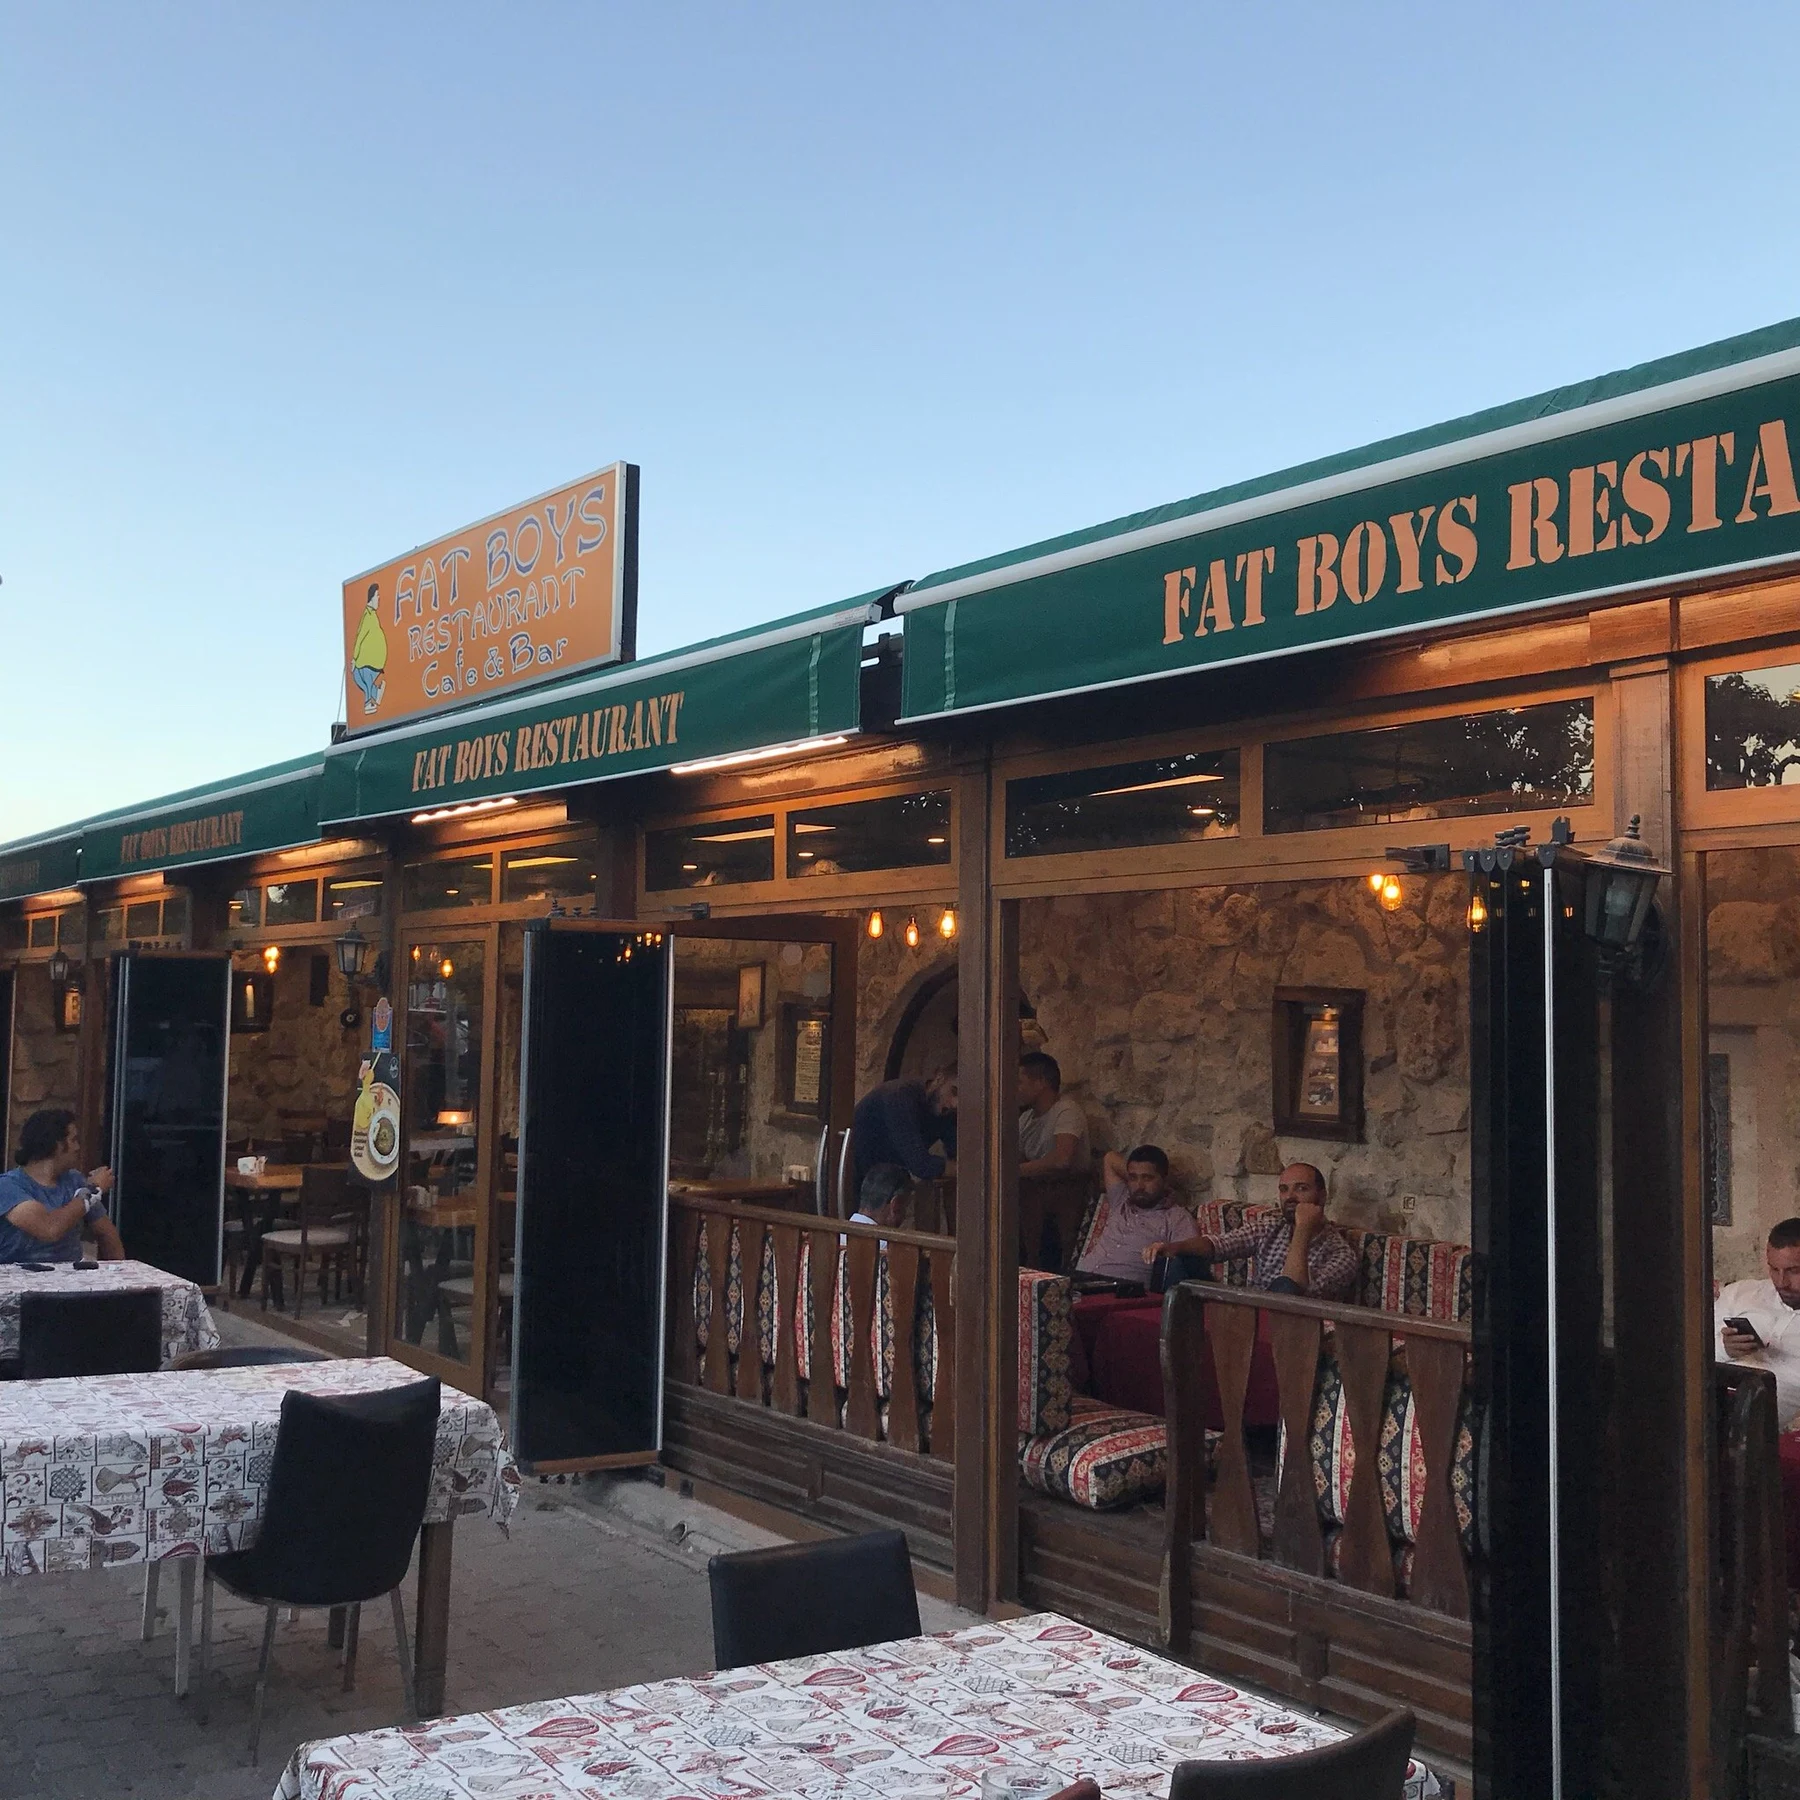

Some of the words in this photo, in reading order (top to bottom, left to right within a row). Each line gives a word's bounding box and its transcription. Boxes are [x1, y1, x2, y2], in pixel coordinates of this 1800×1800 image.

[394, 547, 471, 626] FAT
[485, 484, 608, 592] BOYS
[1163, 546, 1275, 645] FAT
[1295, 494, 1478, 616] BOYS
[1506, 419, 1800, 571] RESTA
[408, 567, 586, 662] RESTAURANT
[421, 648, 478, 698] Cafe
[483, 646, 504, 681] &
[509, 631, 568, 674] Bar
[412, 745, 451, 792] FAT
[453, 730, 510, 784] BOYS
[513, 691, 685, 772] RESTAURANT
